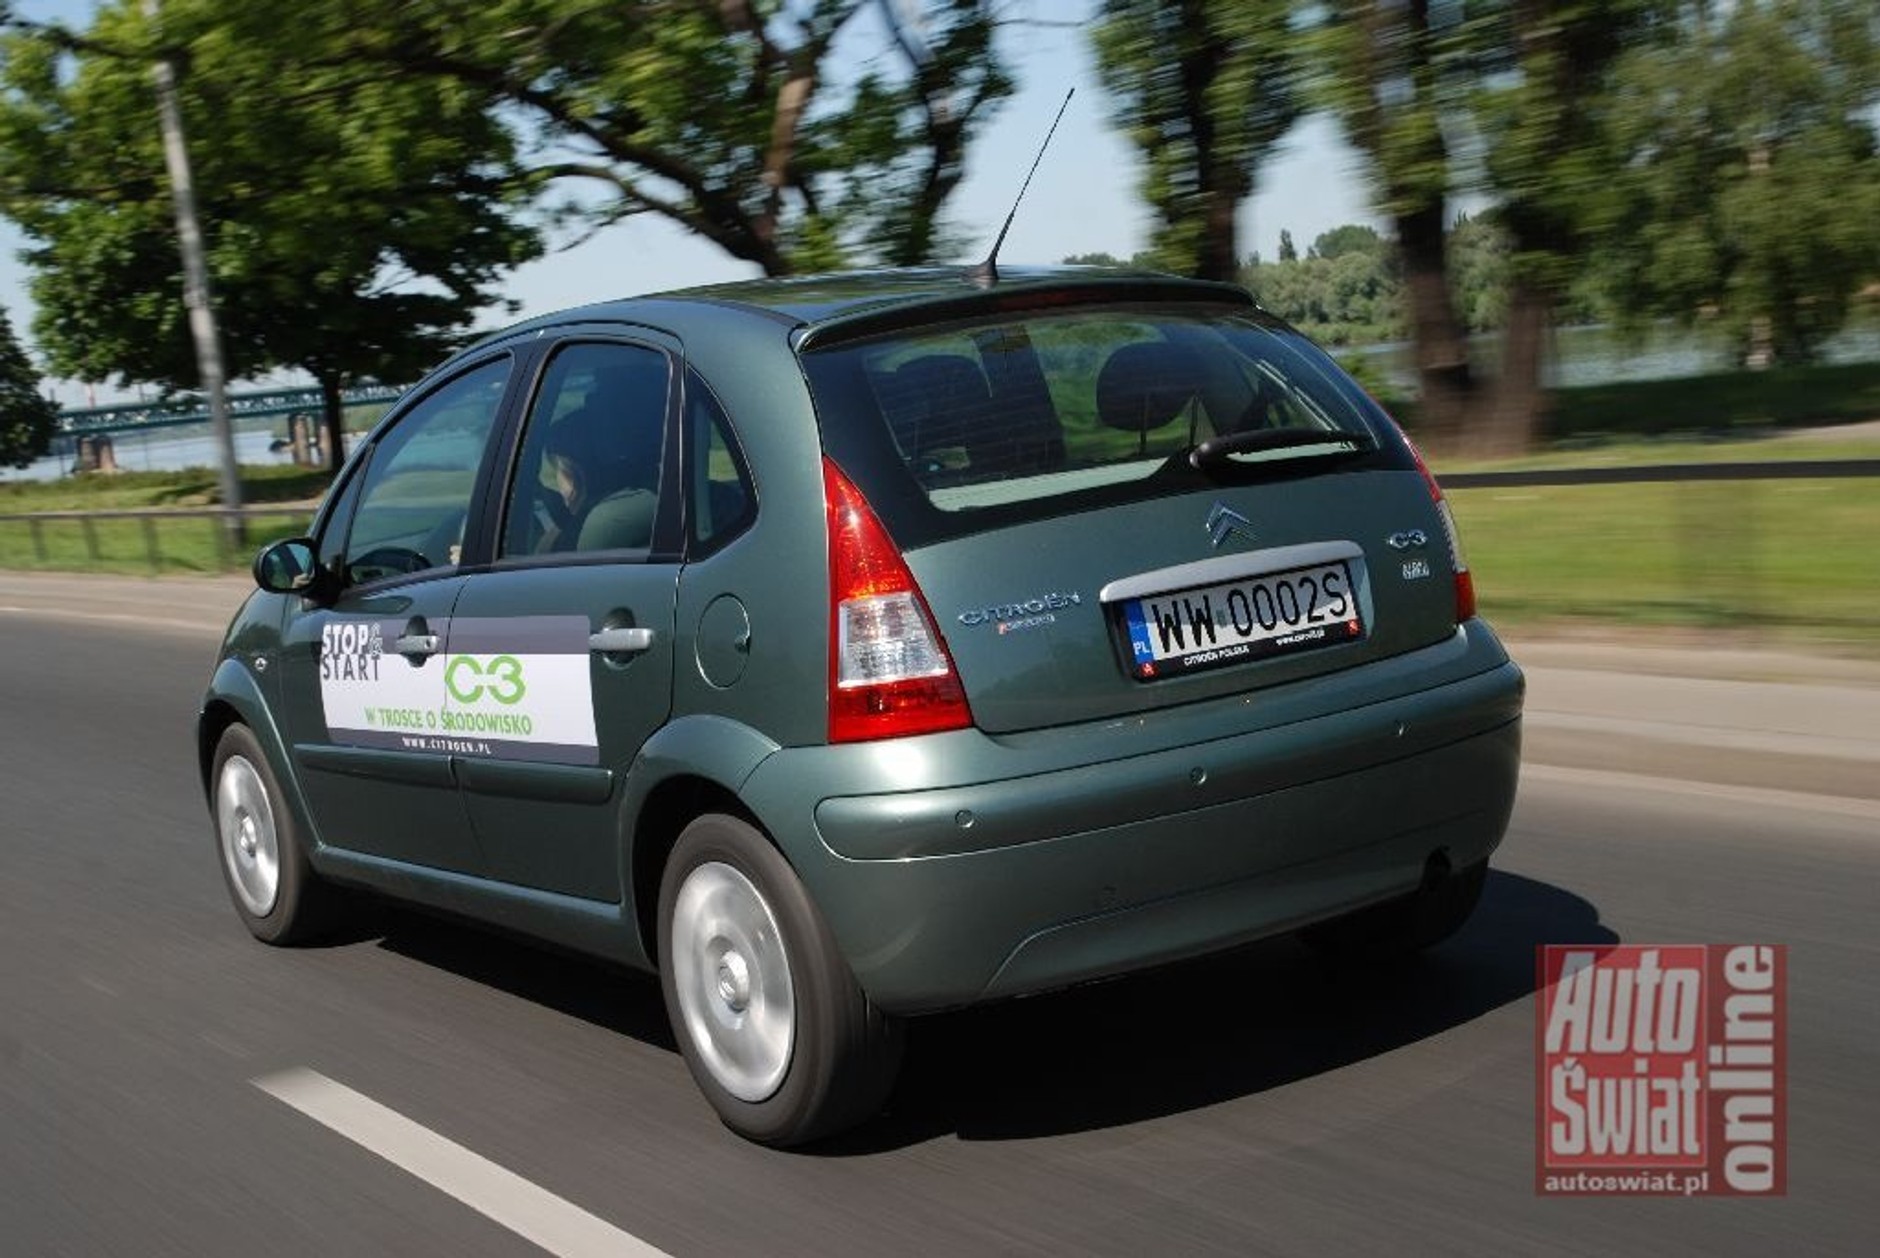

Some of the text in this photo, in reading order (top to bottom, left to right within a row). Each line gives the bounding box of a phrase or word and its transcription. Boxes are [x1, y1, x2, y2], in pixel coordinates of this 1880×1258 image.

[1151, 571, 1347, 653] WW 0002S
[1133, 642, 1150, 656] PL
[321, 653, 381, 682] START
[444, 655, 526, 705] C3
[365, 706, 533, 735] W TROSCE O ŚRODOWISKO
[402, 736, 492, 754] WWW.CITROEN.PL
